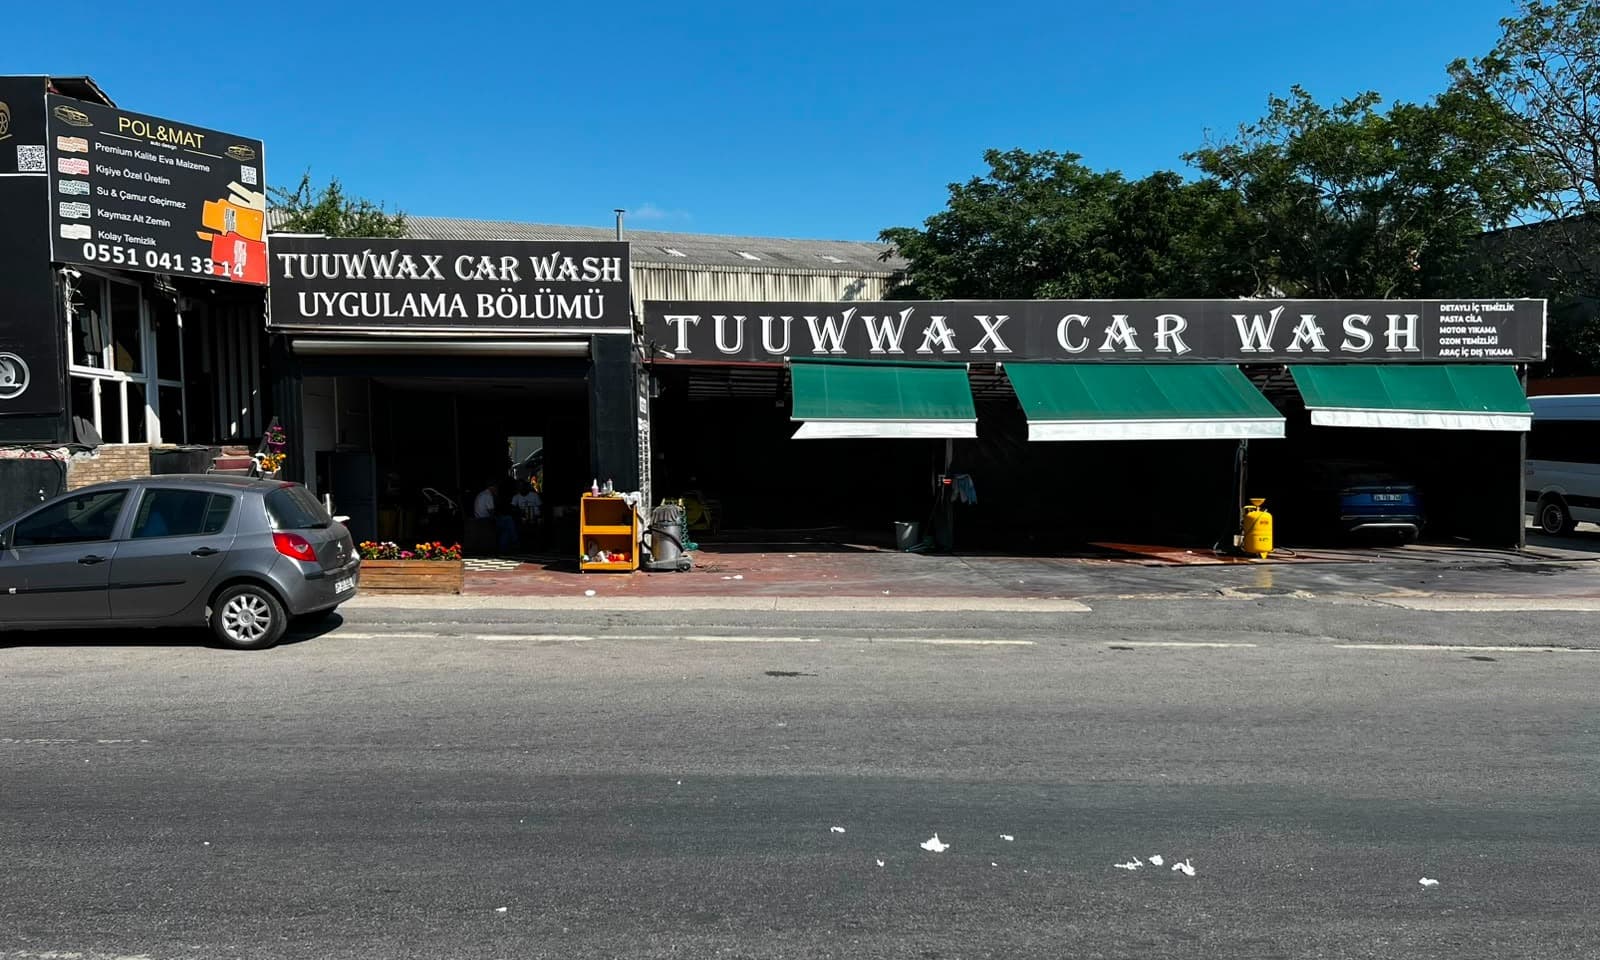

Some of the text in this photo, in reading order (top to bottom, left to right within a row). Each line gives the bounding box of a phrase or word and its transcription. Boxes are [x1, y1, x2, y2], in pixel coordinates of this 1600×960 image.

[118, 116, 205, 149] POL&MAT
[95, 142, 133, 158] Premium
[134, 150, 157, 162] Kalite
[158, 155, 175, 166] Eva
[95, 164, 171, 186] Kişiye Özel Üretim
[96, 186, 187, 209] Su & Çamur Geçirmez
[97, 208, 171, 228] Kaymaz Alt Zemin
[97, 230, 157, 247] Kolay Temizlik
[83, 242, 244, 278] 0551 041 33 14
[276, 249, 623, 282] TUUWWAX CAR WASH
[298, 287, 604, 319] UYGULAMA BÖLÜMÜ
[1440, 302, 1515, 313] DETAYLI İÇ TEMİZLİK
[1439, 313, 1483, 323] PASTA CİLA
[663, 305, 1421, 356] TUUWWAX CAR WASH
[1439, 326, 1497, 334] MOTOR YIKAMA
[1439, 346, 1514, 358] ARAÇ İÇ DIŞ YIKAMA
